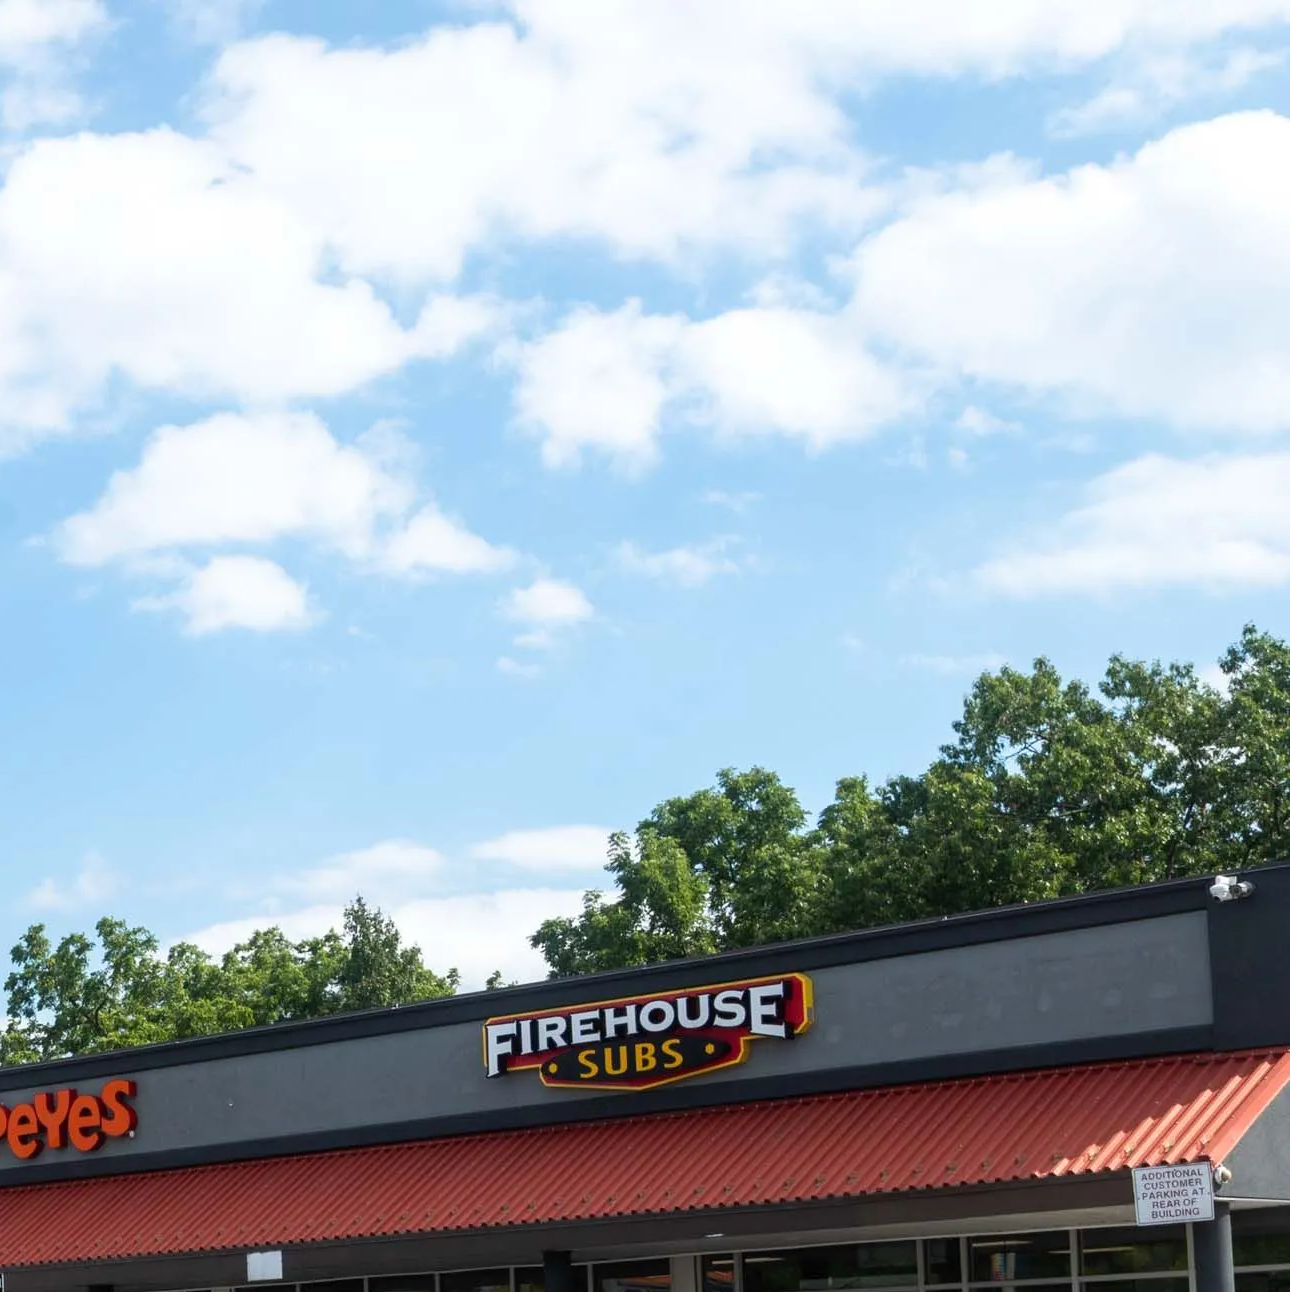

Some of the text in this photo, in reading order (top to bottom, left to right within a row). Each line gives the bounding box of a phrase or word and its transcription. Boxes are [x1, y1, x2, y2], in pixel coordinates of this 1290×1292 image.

[486, 981, 788, 1078] FIREHOUSE
[578, 1038, 684, 1079] SUBS
[1141, 1168, 1203, 1181] ADDITIONAL
[1144, 1178, 1203, 1190] CUSTOMER
[1142, 1187, 1205, 1200] PARKING AT
[1152, 1198, 1197, 1209] REAR OF
[1151, 1208, 1200, 1219] BUILDING
